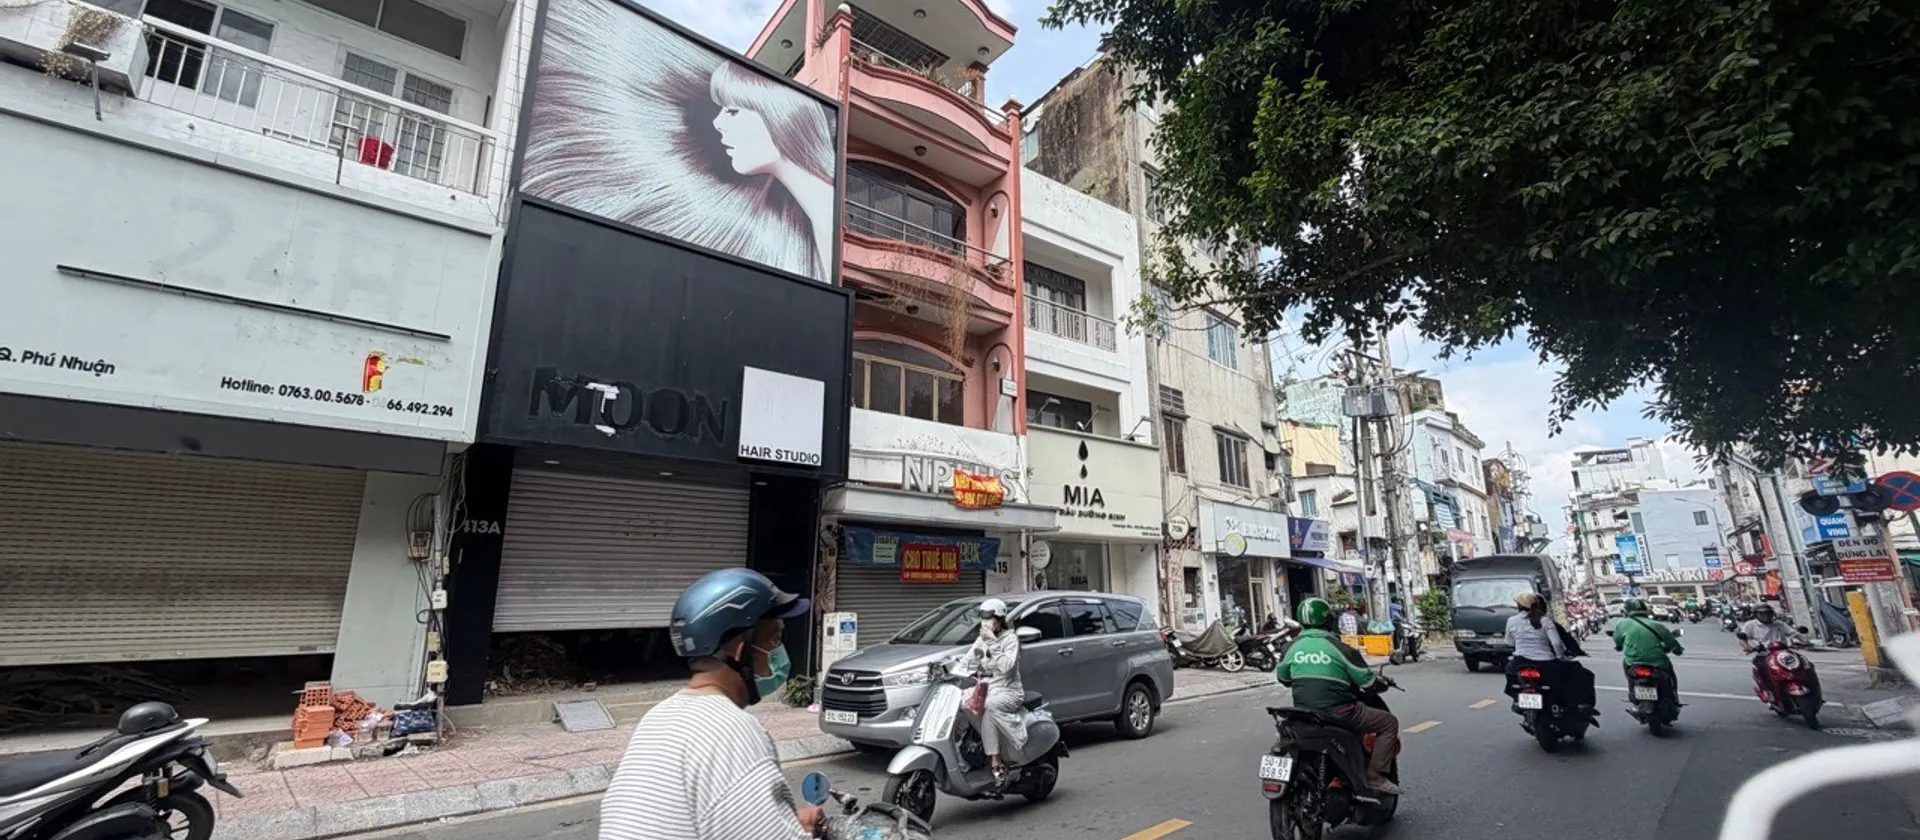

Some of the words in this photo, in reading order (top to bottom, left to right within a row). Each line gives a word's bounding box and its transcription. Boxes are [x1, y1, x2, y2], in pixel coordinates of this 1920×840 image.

[21, 349, 57, 367] Phú
[59, 354, 116, 377] Nhuận
[219, 375, 275, 396] Hotline:
[740, 443, 773, 460] HAIR
[775, 448, 821, 465] STUDIO
[902, 455, 1017, 502] NPS
[1063, 484, 1105, 508] MIA
[993, 561, 1008, 575] 15
[1294, 651, 1331, 664] Grab
